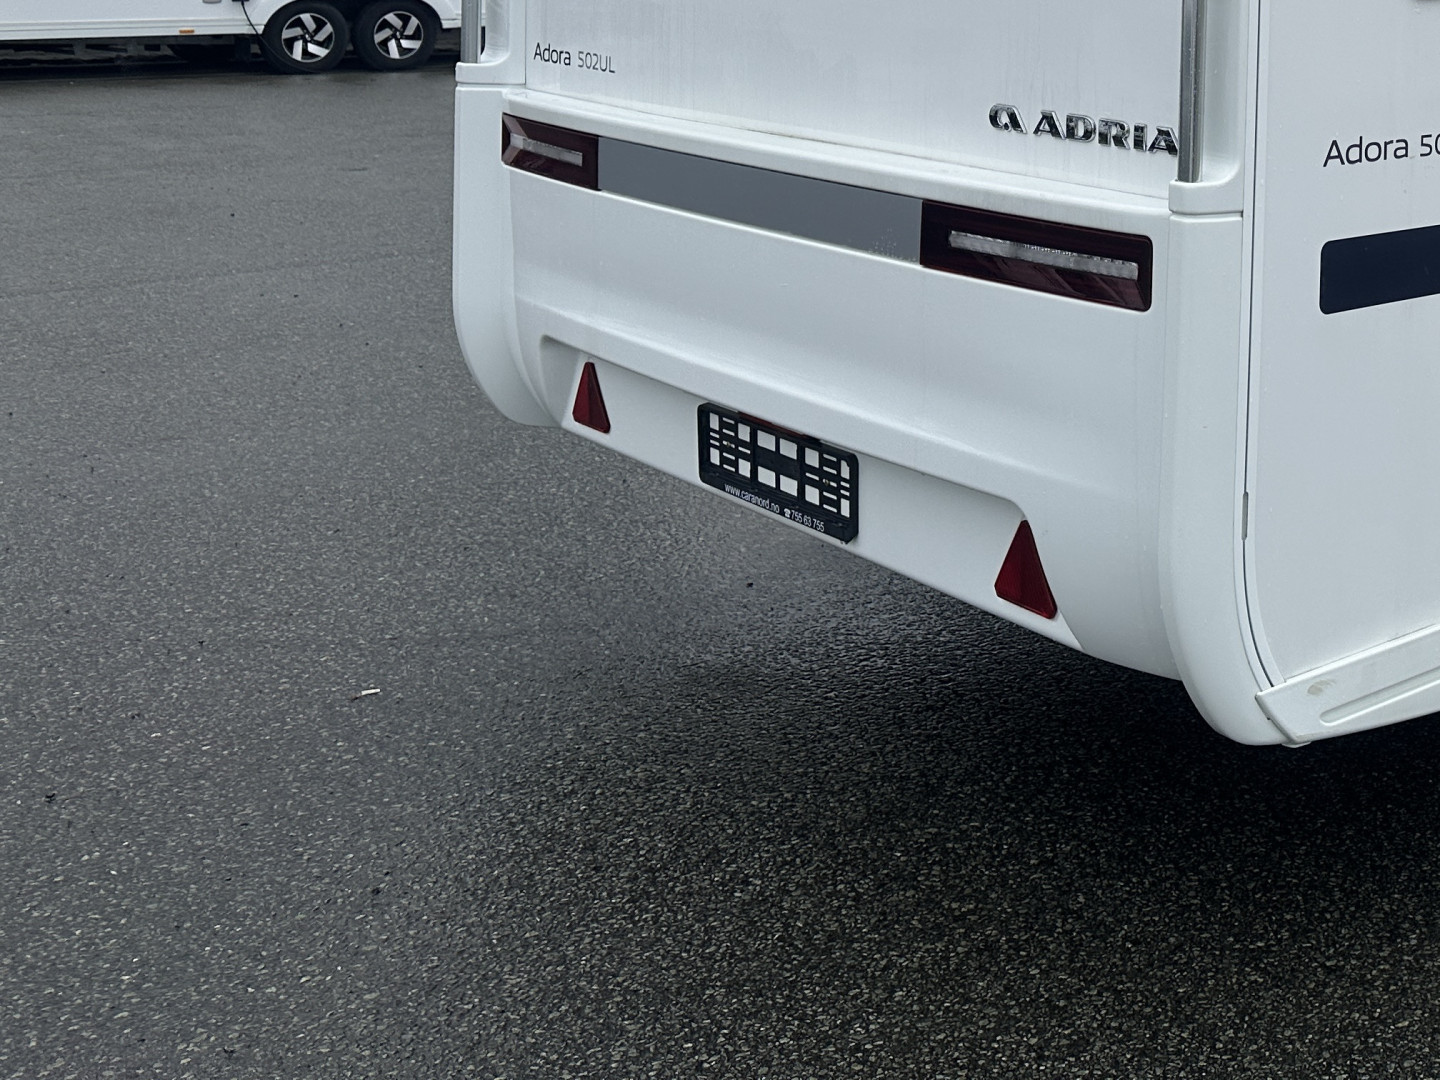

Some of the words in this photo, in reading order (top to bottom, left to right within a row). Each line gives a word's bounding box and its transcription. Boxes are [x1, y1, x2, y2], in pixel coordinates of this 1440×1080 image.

[533, 41, 571, 66] Adora
[577, 50, 616, 74] 502UL
[1033, 109, 1179, 155] ADRIA
[1322, 135, 1409, 168] Adora
[724, 483, 780, 514] www.caranord.no
